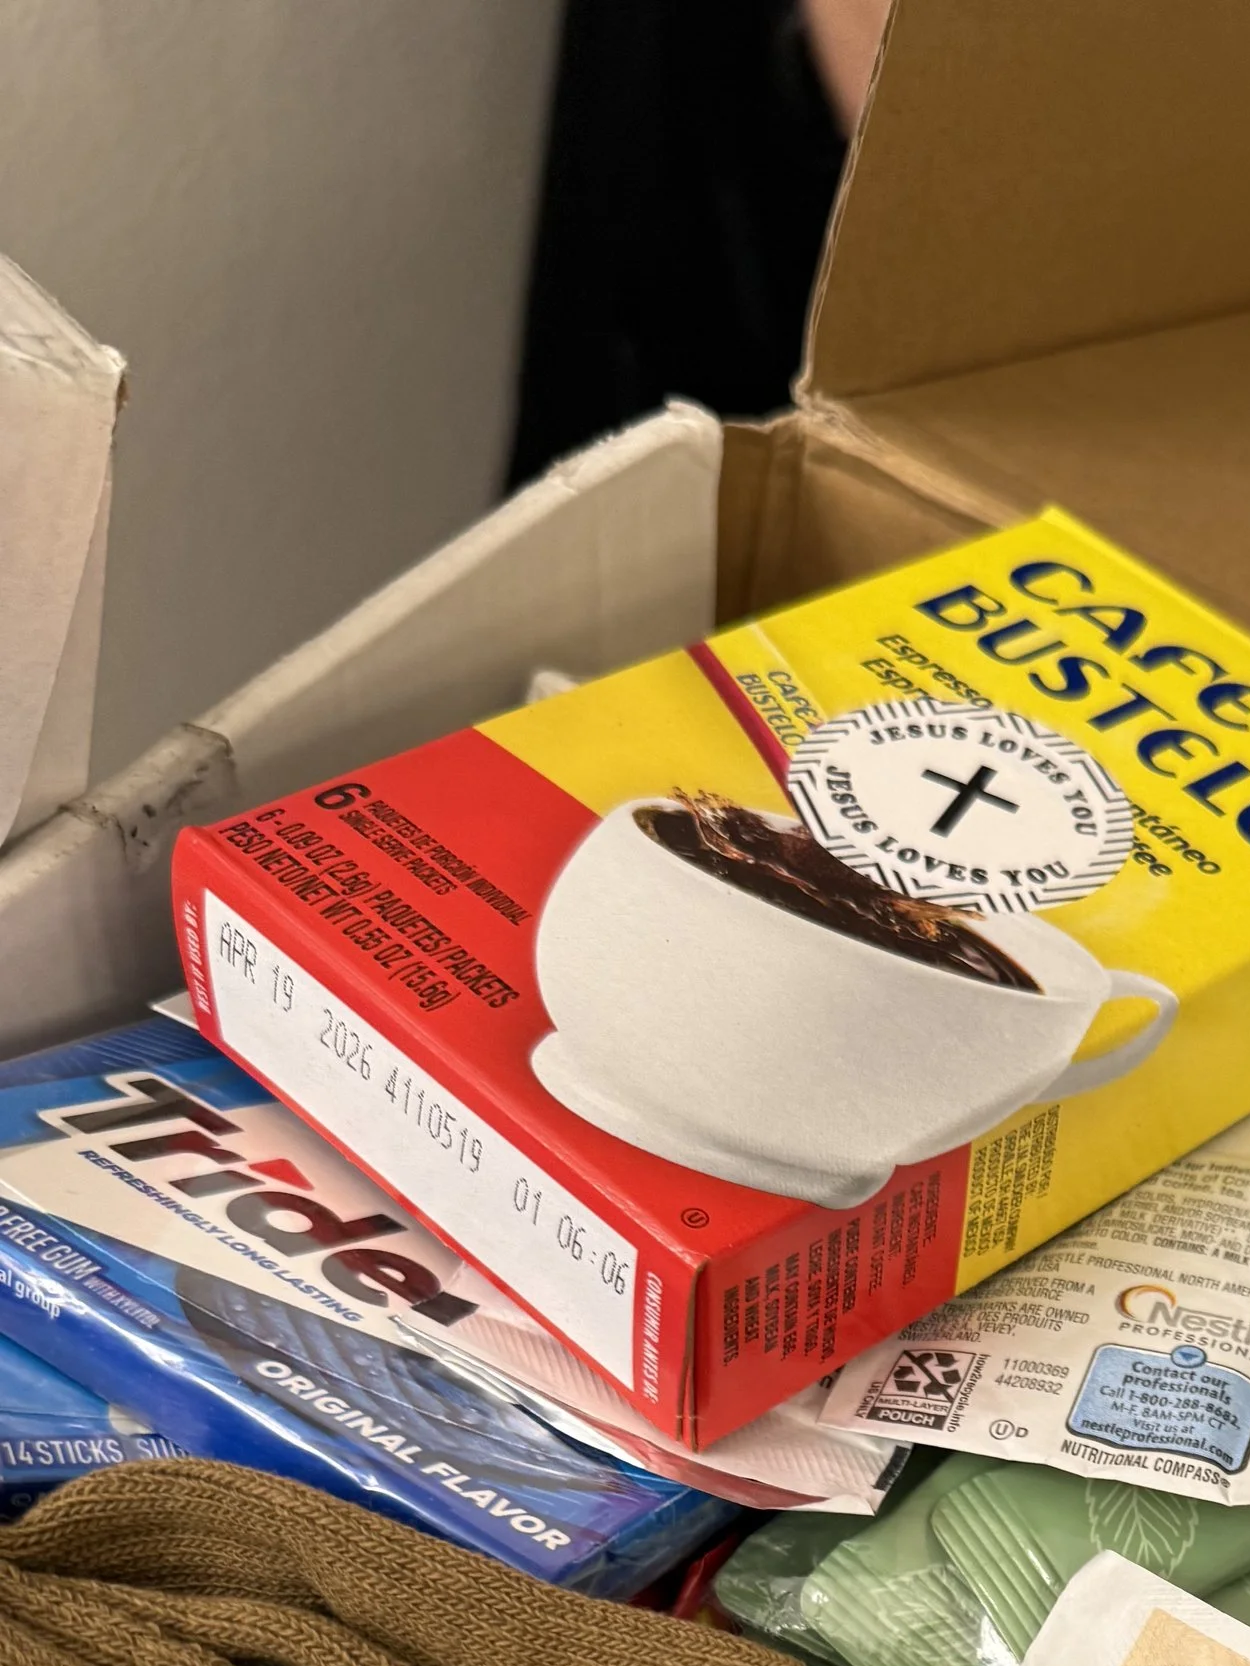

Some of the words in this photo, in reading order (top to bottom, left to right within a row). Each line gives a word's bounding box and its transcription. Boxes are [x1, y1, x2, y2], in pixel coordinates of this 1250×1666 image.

[736, 673, 806, 747] BUSTELO
[876, 634, 993, 711] Espresso
[1131, 803, 1222, 875] ntáneo
[869, 723, 969, 747] JESUS
[978, 732, 1077, 793] LOVES
[1062, 783, 1100, 838] YOU
[255, 808, 285, 823] 6
[825, 764, 878, 836] JESUS
[875, 836, 990, 887] LOVES
[1000, 860, 1072, 888] YOU
[218, 821, 273, 855] PESO
[276, 822, 324, 851] 0.09
[338, 810, 385, 840] SINGLE
[371, 828, 417, 863] SERVE
[402, 856, 458, 896] PACKETS
[304, 844, 345, 866] OZ
[314, 783, 372, 810] 6
[363, 799, 424, 839] PAQUETES
[465, 879, 532, 927] INDIVIDUAL
[254, 848, 341, 907] NETO/NET
[318, 859, 382, 898] (2.6g)
[318, 898, 363, 926] WT
[185, 927, 203, 966] USED
[342, 918, 392, 951] 0.55
[364, 889, 521, 1010] PAQUETES/PACKETS
[373, 943, 415, 969] OZ
[387, 960, 461, 1012] (15.6g)
[219, 921, 258, 985] APR
[272, 964, 295, 1013] 19
[319, 1007, 374, 1081] 2026
[384, 1066, 484, 1174] 4110519
[511, 1177, 543, 1227] 01
[556, 1214, 627, 1297] 06:06
[60, 1077, 480, 1327] Tride
[3, 1215, 59, 1253] FREE
[40, 1244, 102, 1281] GUM
[77, 1149, 228, 1242] REFRESHINGLY
[215, 1233, 283, 1273] LONG
[270, 1268, 365, 1324] LASTING
[1050, 1278, 1085, 1294] FROM
[1086, 1283, 1097, 1298] A
[1085, 1255, 1177, 1283] PROFESSIONAL
[1176, 1270, 1222, 1291] NORTH
[15, 1279, 61, 1320] group
[1018, 1302, 1044, 1318] ARE
[1044, 1306, 1092, 1326] OWNED
[993, 1372, 1065, 1397] 44208932
[1002, 1357, 1071, 1380] 11000369
[1131, 1360, 1199, 1382] Contact
[1200, 1375, 1232, 1390] our
[876, 1396, 952, 1414] MULTI-LAYER
[946, 1352, 992, 1434] how2recycle.info
[1099, 1384, 1125, 1401] Call
[1122, 1373, 1233, 1407] professionals
[877, 1408, 937, 1428] POUCH
[1180, 1424, 1197, 1436] at
[1206, 1416, 1228, 1431] CT
[2, 1441, 34, 1466] 14
[34, 1438, 125, 1465] STICKS
[253, 1358, 421, 1468] ORIGINAL
[420, 1460, 574, 1552] FLAVOR
[1060, 1439, 1150, 1471] NUTRITIONAL
[1080, 1416, 1236, 1467] nestleprofessional.com
